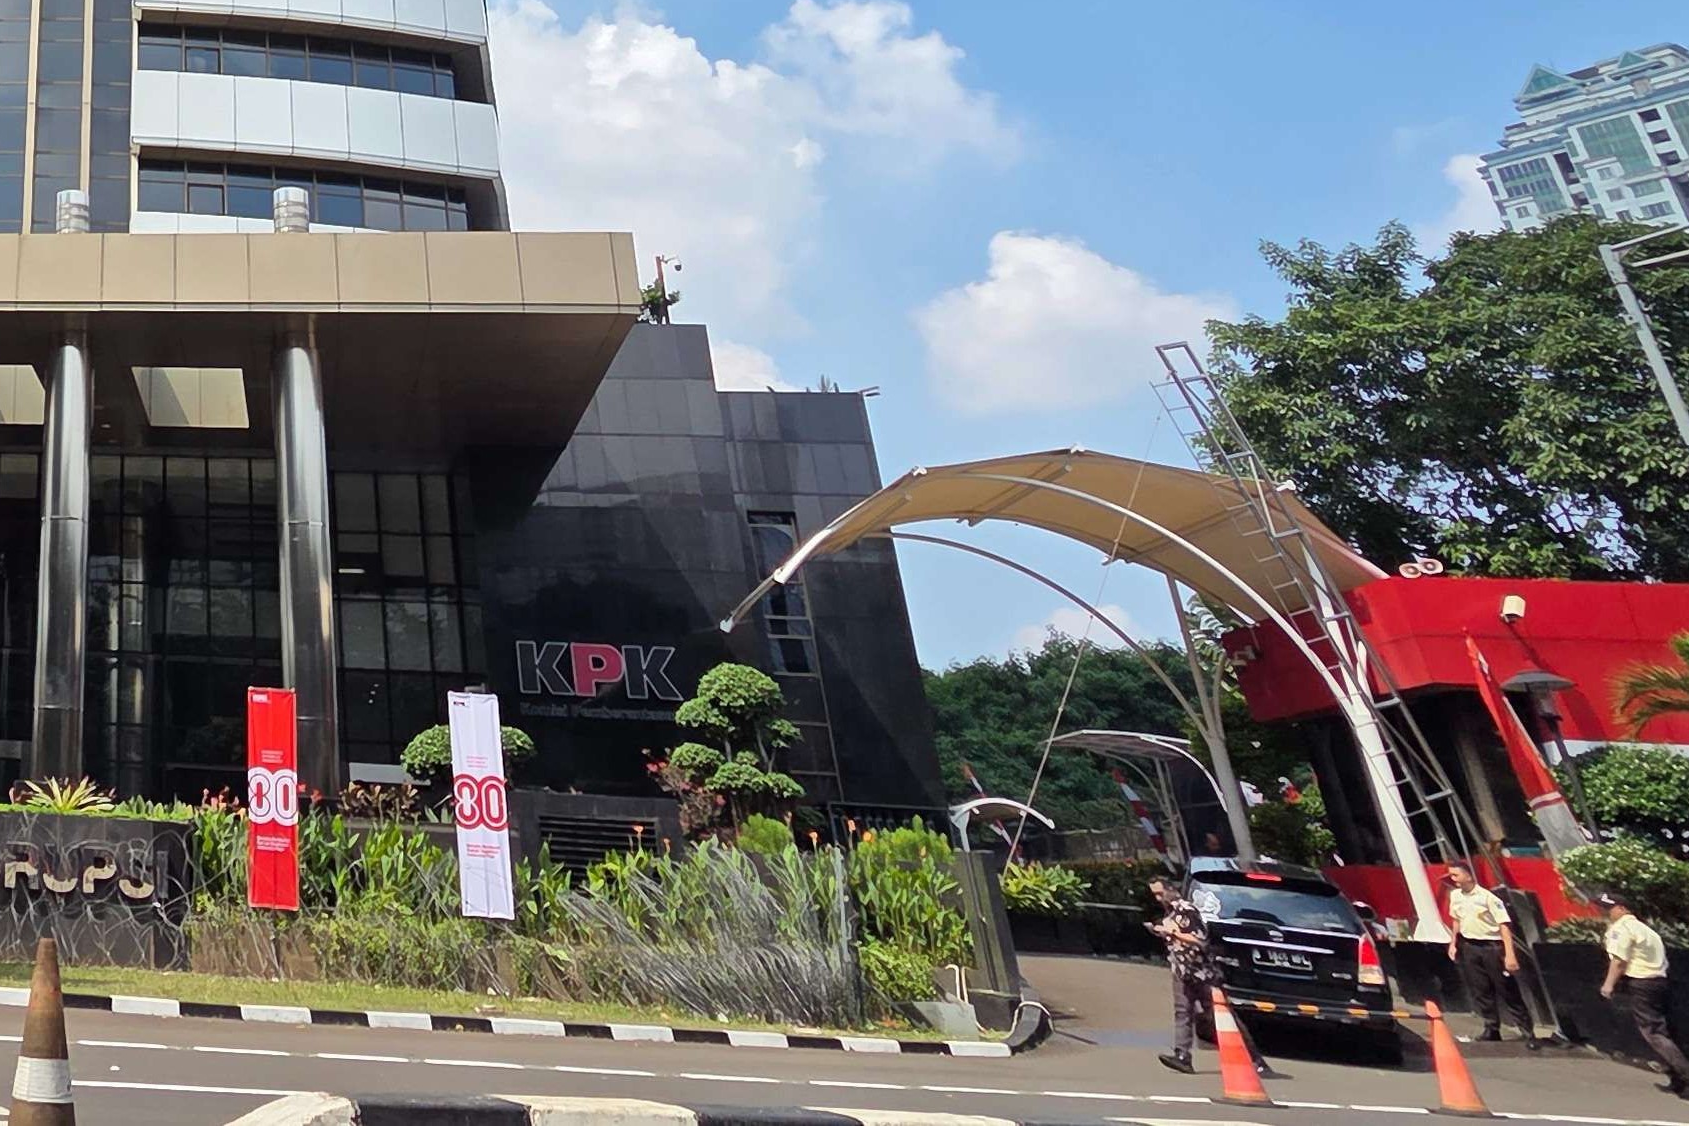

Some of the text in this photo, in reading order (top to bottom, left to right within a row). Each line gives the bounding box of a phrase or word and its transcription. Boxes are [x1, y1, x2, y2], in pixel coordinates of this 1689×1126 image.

[515, 640, 684, 701] KPK
[248, 767, 298, 826] 80
[453, 773, 508, 832] 80
